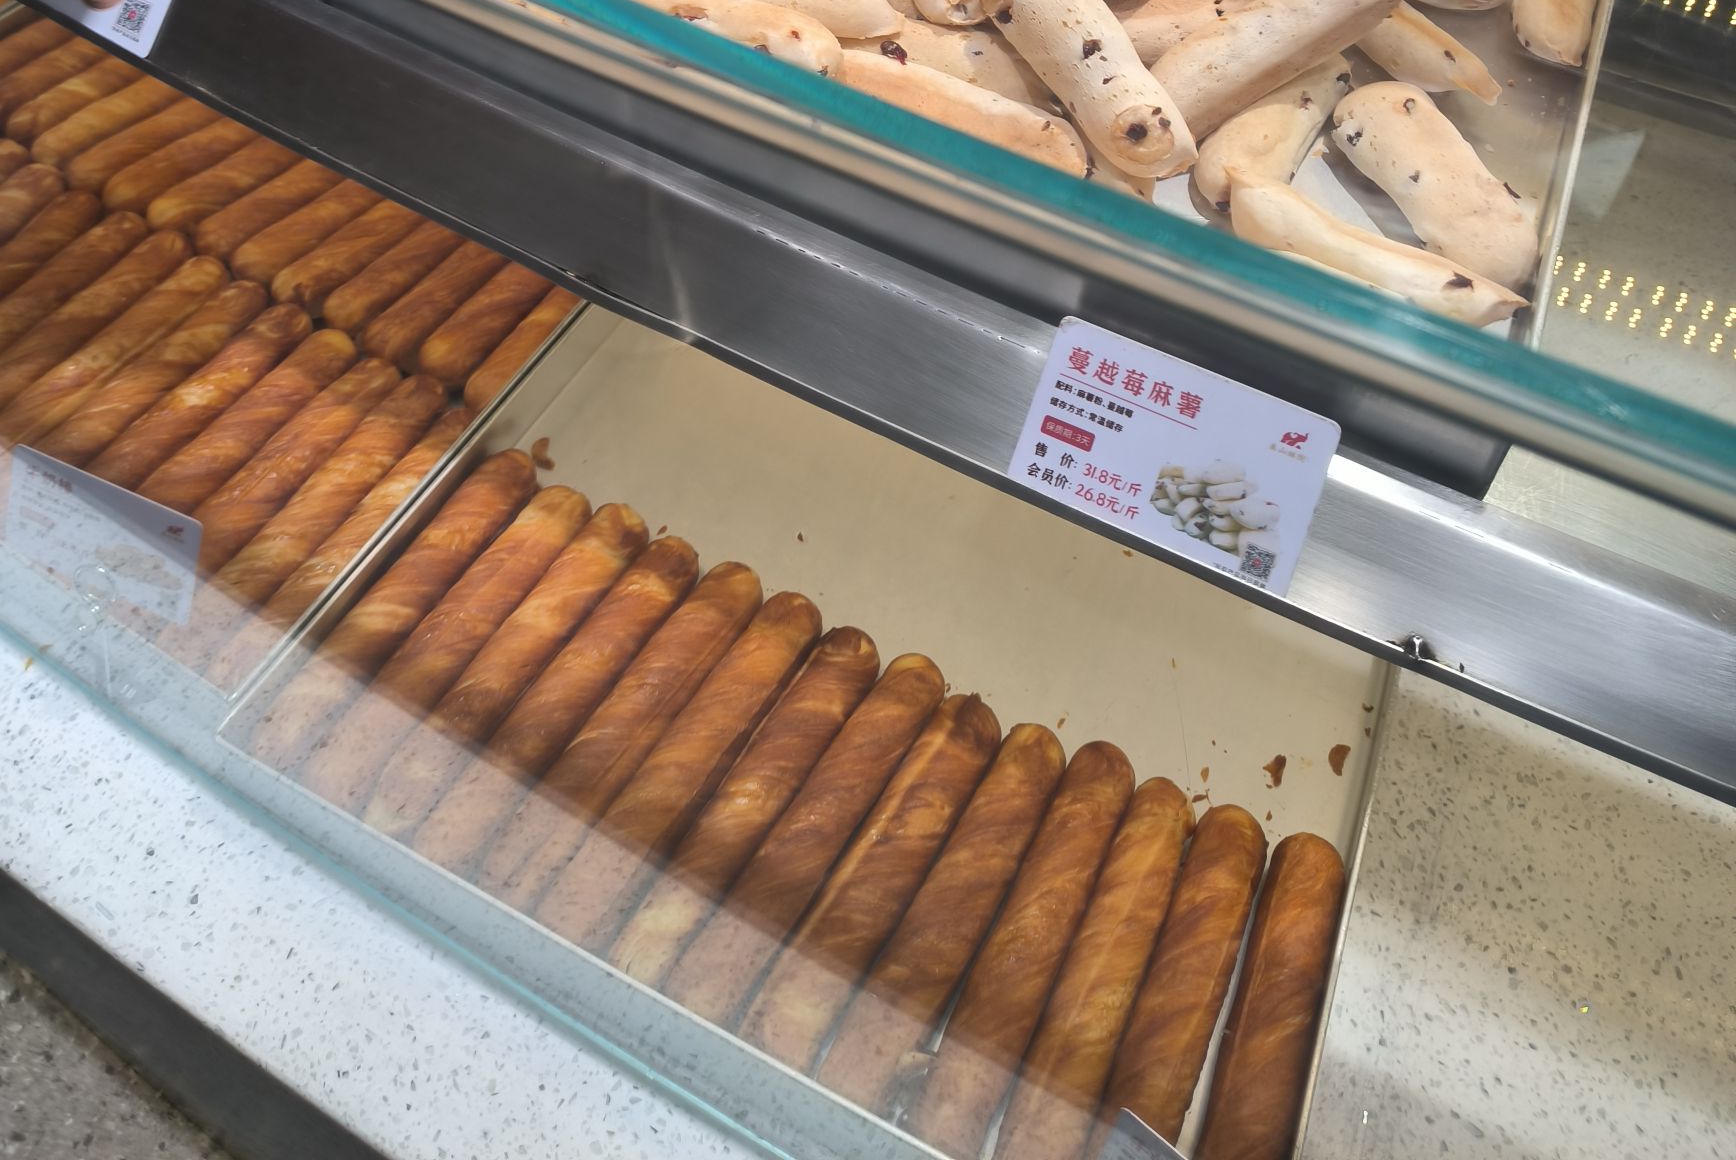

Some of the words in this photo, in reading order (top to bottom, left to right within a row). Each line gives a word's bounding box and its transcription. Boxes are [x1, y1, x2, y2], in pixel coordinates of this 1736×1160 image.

[1068, 346, 1204, 419] 蔓越莓麻薯
